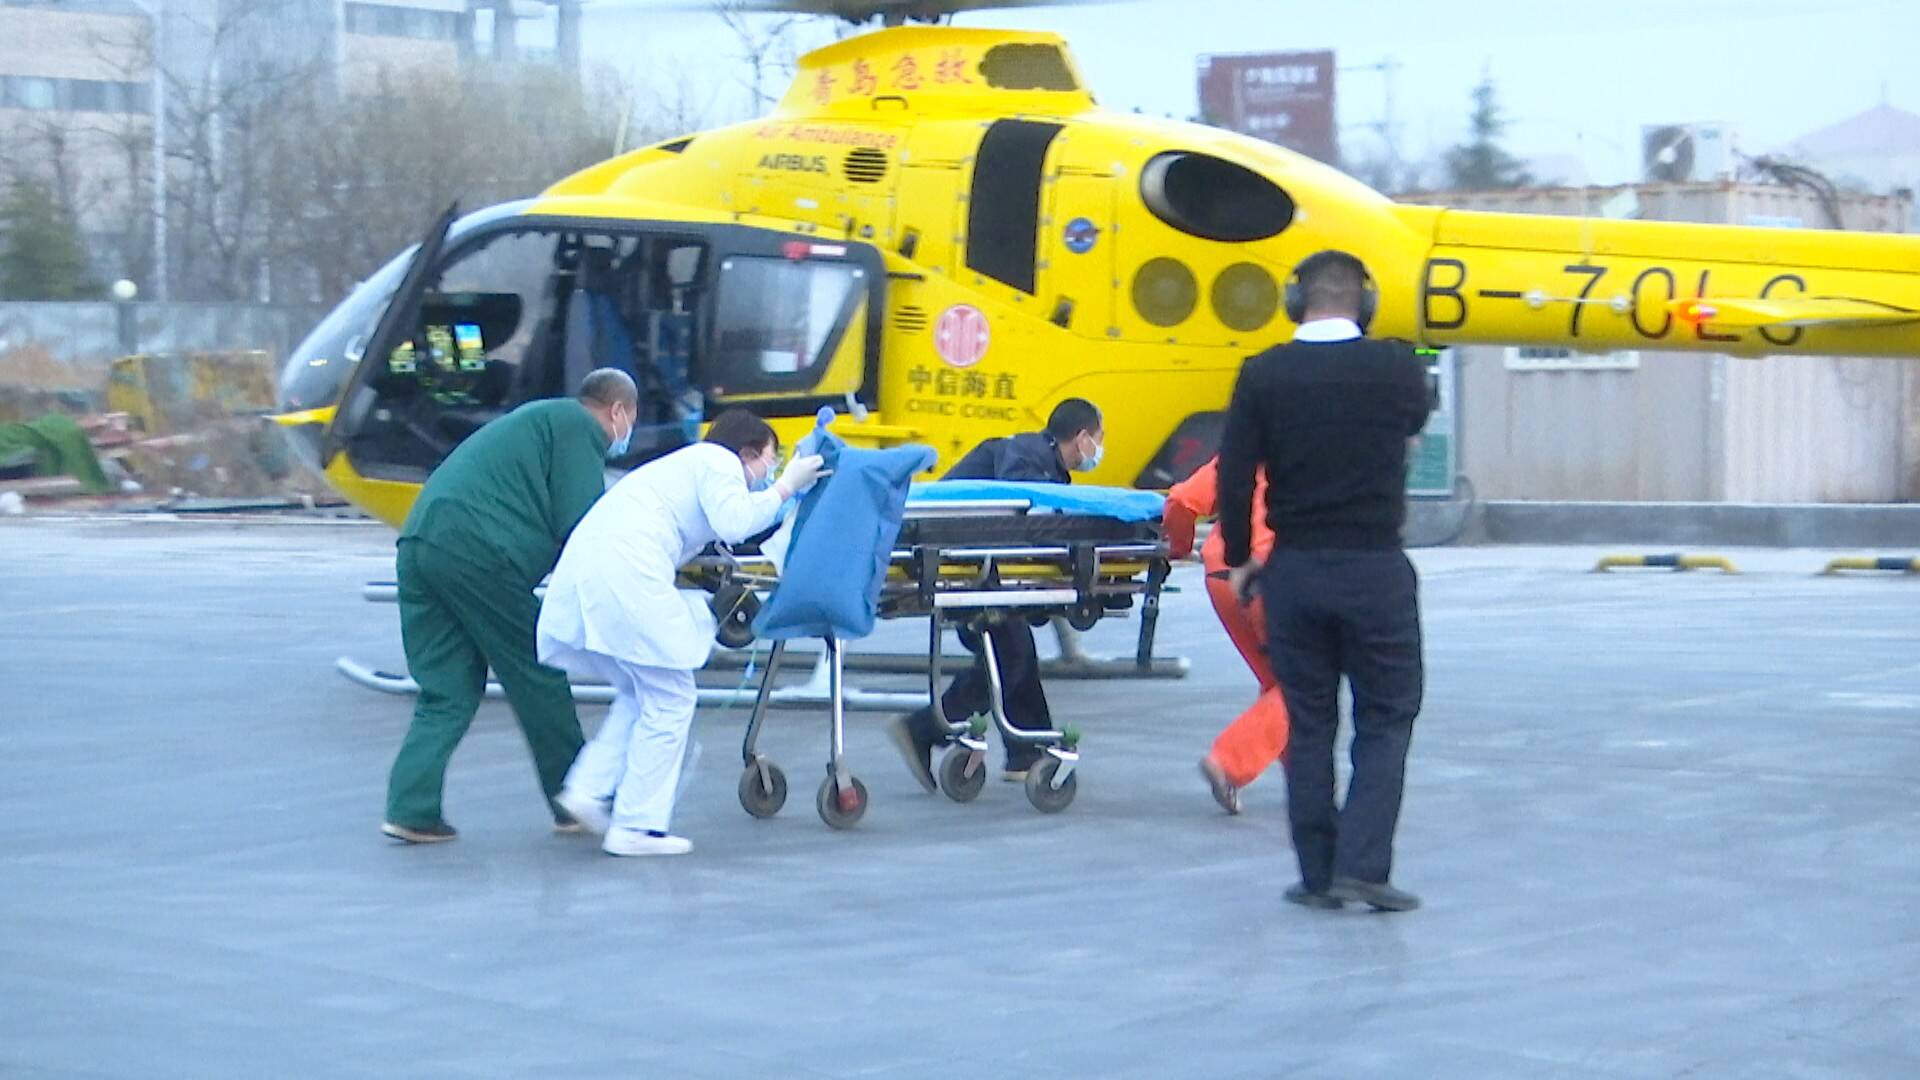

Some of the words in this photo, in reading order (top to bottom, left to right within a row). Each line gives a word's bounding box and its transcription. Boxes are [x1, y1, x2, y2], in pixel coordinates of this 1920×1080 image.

[757, 152, 827, 173] AIRBUS
[907, 364, 1018, 400] 中信海直
